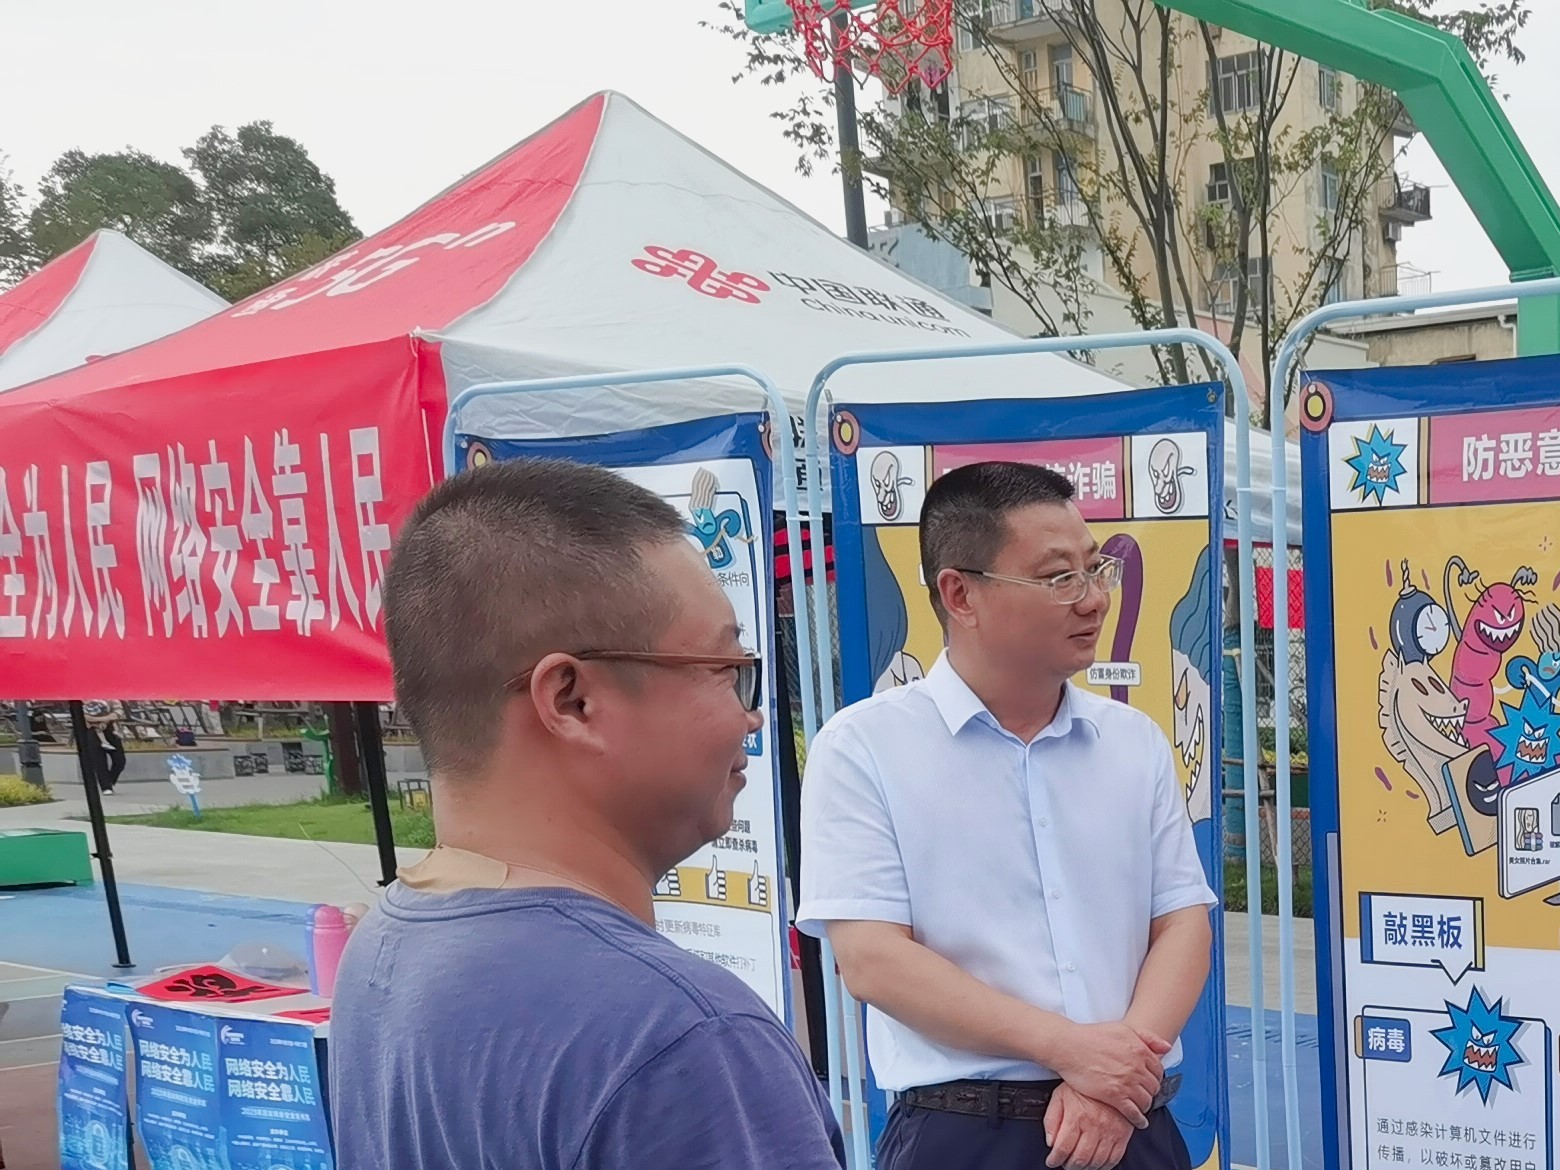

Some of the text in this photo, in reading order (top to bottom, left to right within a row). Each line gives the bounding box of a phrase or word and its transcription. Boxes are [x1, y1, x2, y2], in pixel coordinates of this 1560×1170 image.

[767, 271, 951, 322] 中国联通
[133, 427, 392, 638] 网络安全靠人民
[1383, 912, 1464, 950] 敲黑板
[1368, 1026, 1406, 1053] 病毒
[1376, 1117, 1537, 1151] 通过感染计算机文件进行
